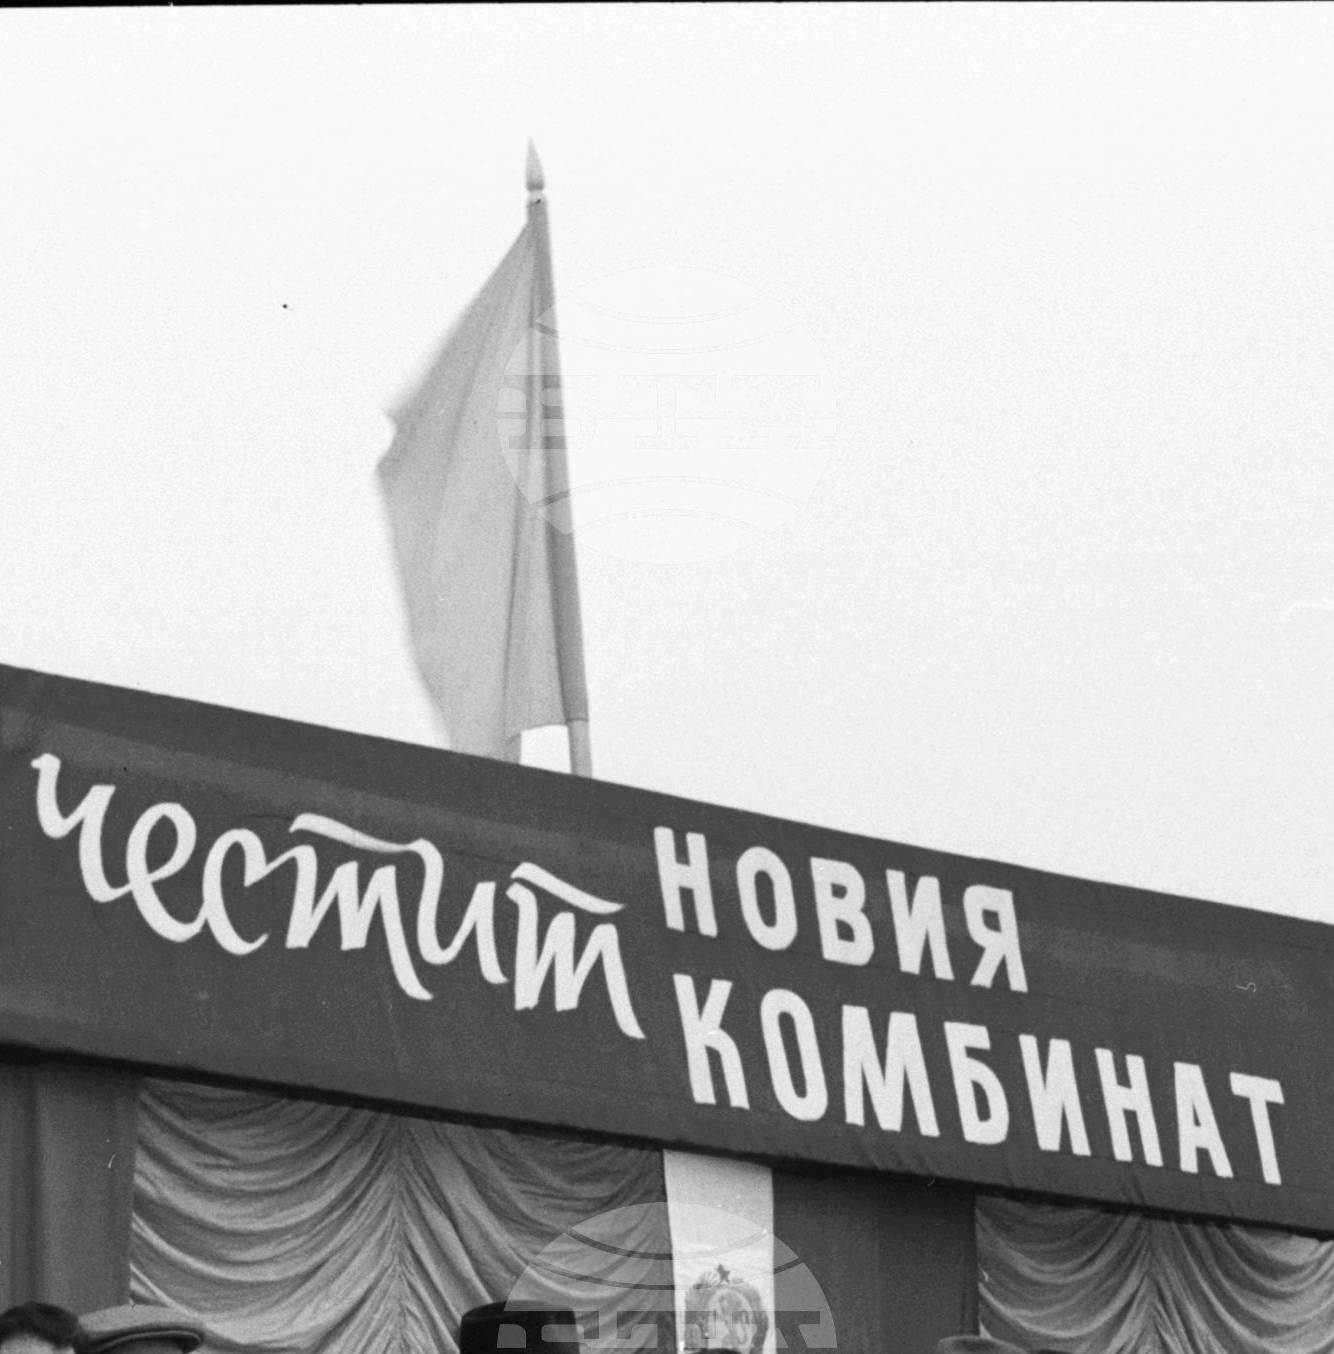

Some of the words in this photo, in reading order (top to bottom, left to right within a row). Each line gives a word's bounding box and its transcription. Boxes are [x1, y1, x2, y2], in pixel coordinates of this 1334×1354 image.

[32, 754, 644, 1038] честит
[654, 827, 1027, 991] НОВИЯ
[674, 974, 1284, 1184] КОМБИНАТ
